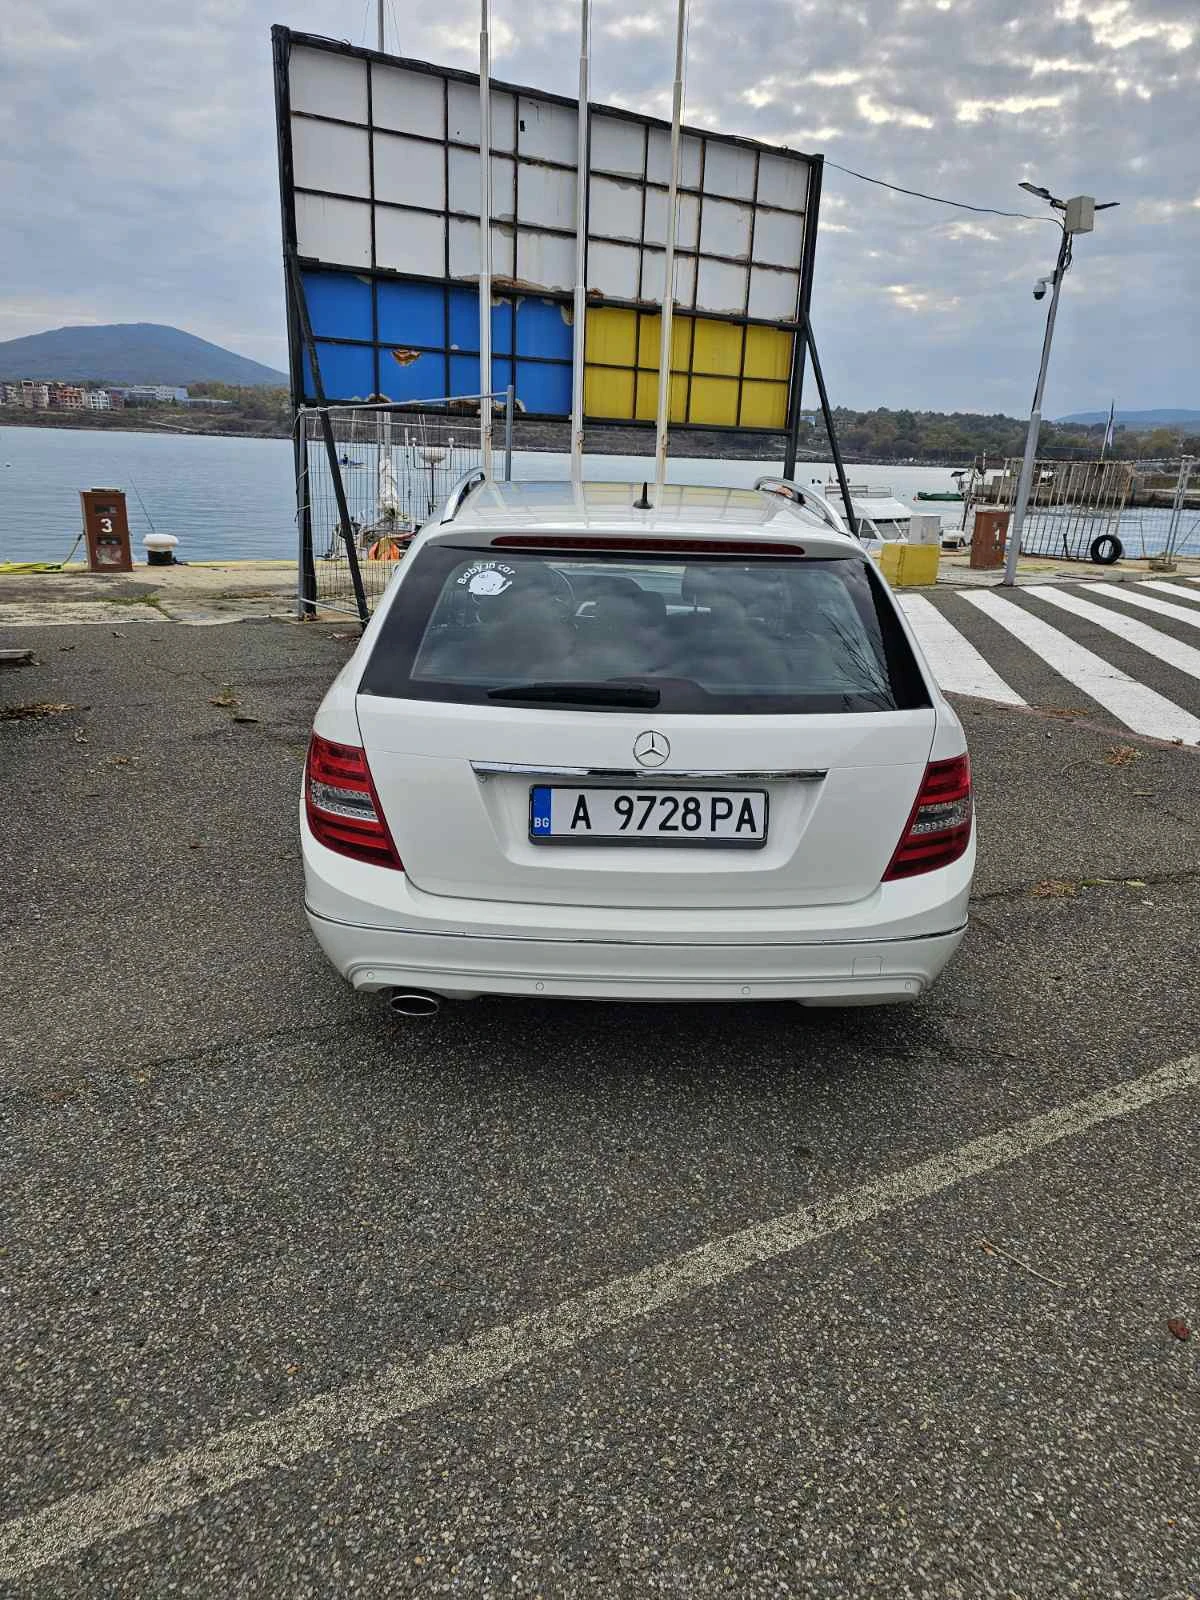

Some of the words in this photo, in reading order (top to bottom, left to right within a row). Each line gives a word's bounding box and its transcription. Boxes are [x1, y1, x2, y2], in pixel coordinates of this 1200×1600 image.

[100, 518, 113, 533] 3
[570, 794, 592, 830] A
[613, 795, 702, 832] 9728
[710, 797, 757, 833] PA
[534, 817, 550, 828] BG
